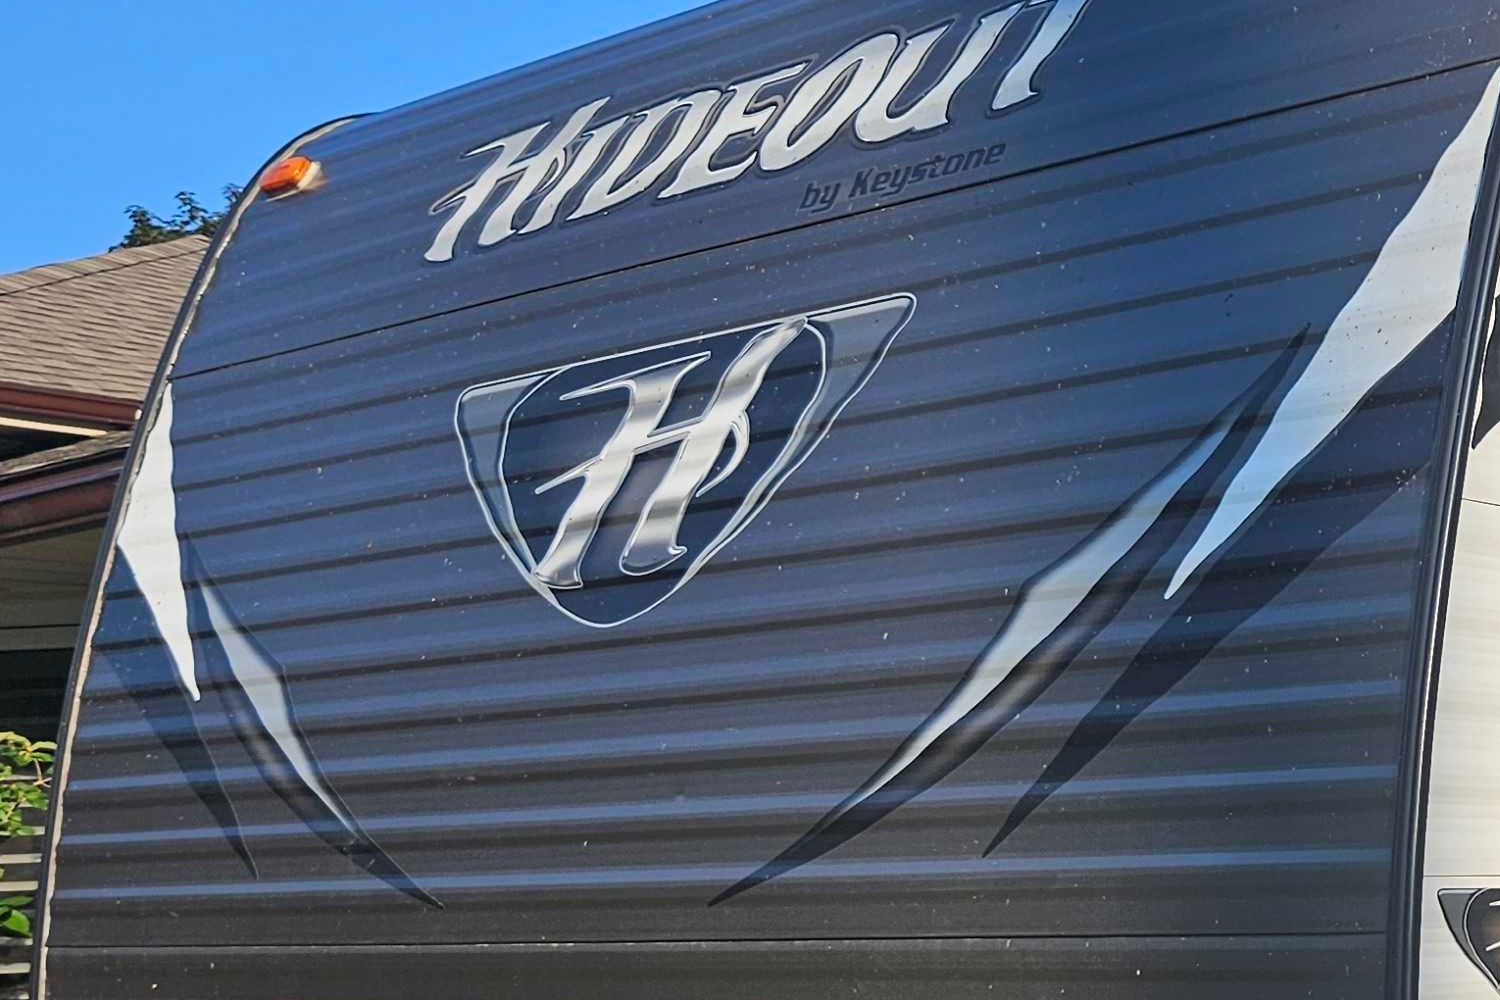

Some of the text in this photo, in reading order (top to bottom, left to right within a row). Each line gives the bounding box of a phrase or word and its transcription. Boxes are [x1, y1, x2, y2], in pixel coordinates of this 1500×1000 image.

[422, 0, 1092, 263] HIDEOUT
[800, 143, 1006, 214] by Keystone
